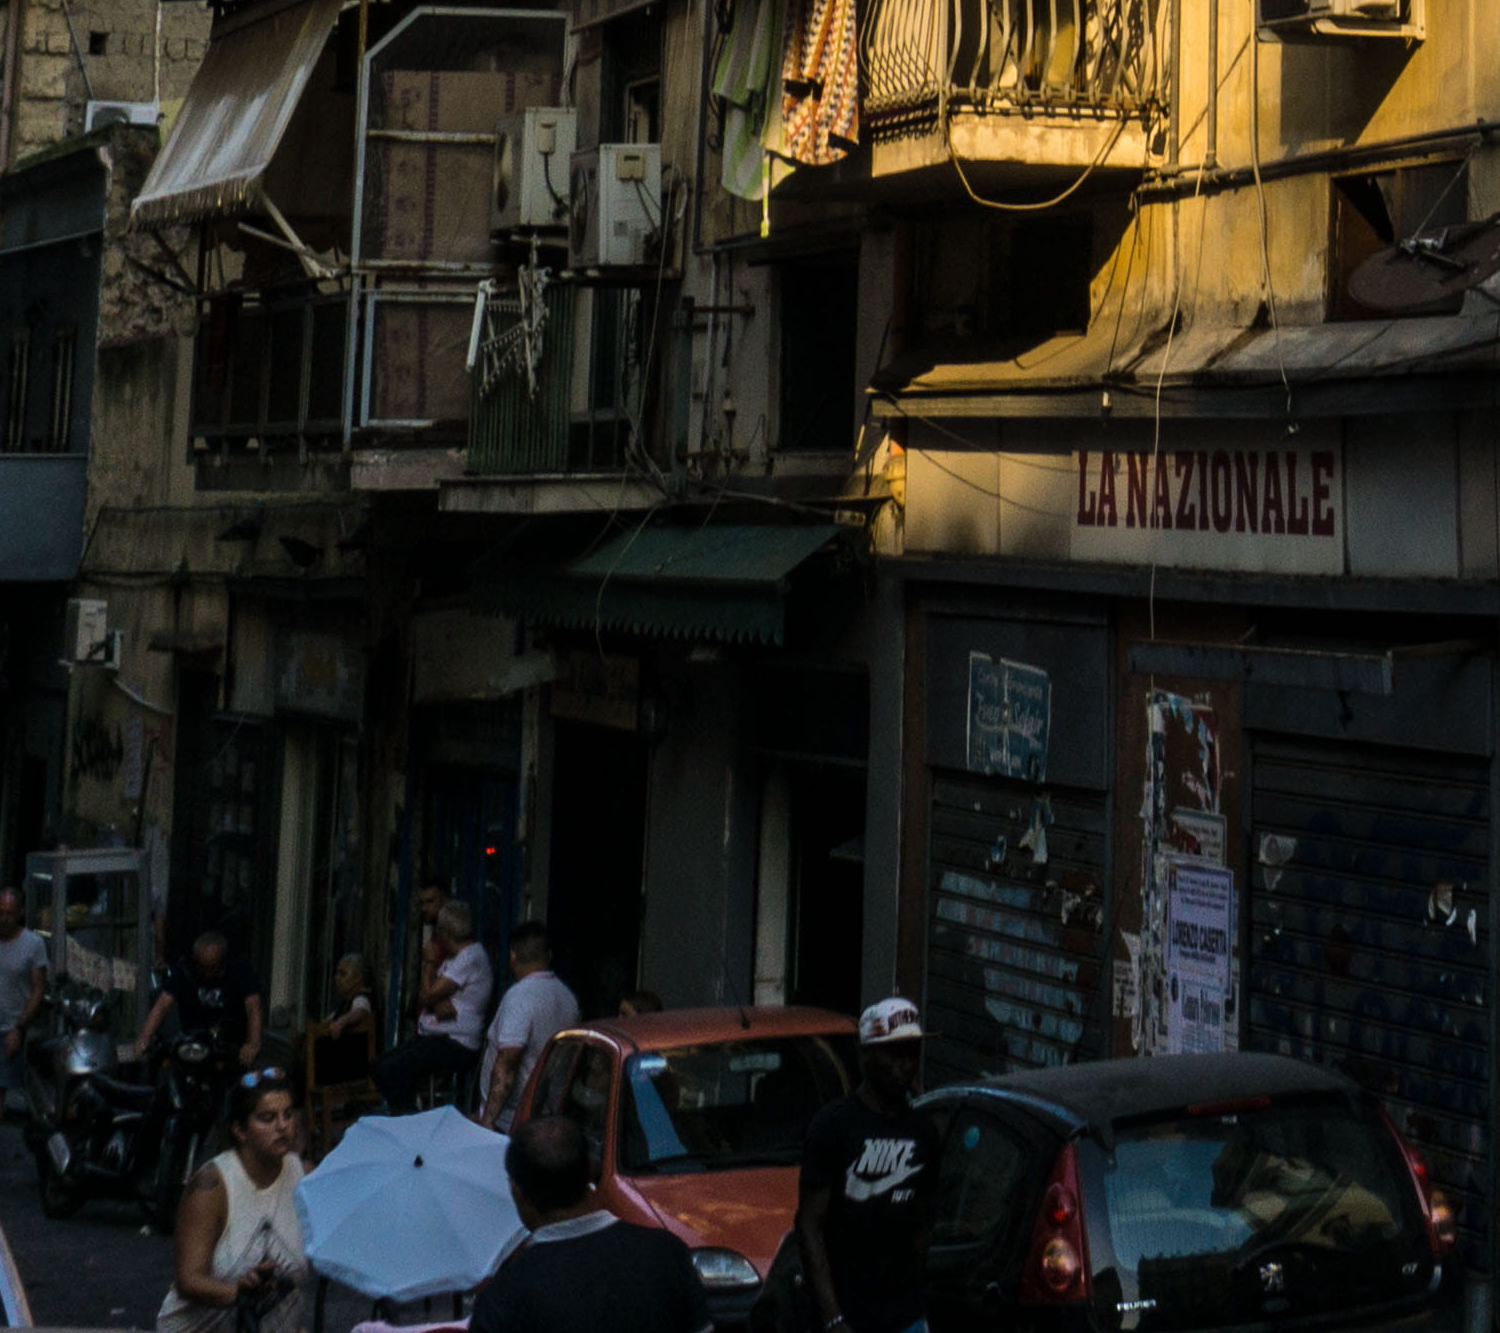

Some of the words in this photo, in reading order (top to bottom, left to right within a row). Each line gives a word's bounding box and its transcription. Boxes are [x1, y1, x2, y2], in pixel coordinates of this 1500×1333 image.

[1077, 449, 1118, 527] LA
[1126, 449, 1335, 537] NAZIONALE
[856, 1137, 917, 1175] NIKE
